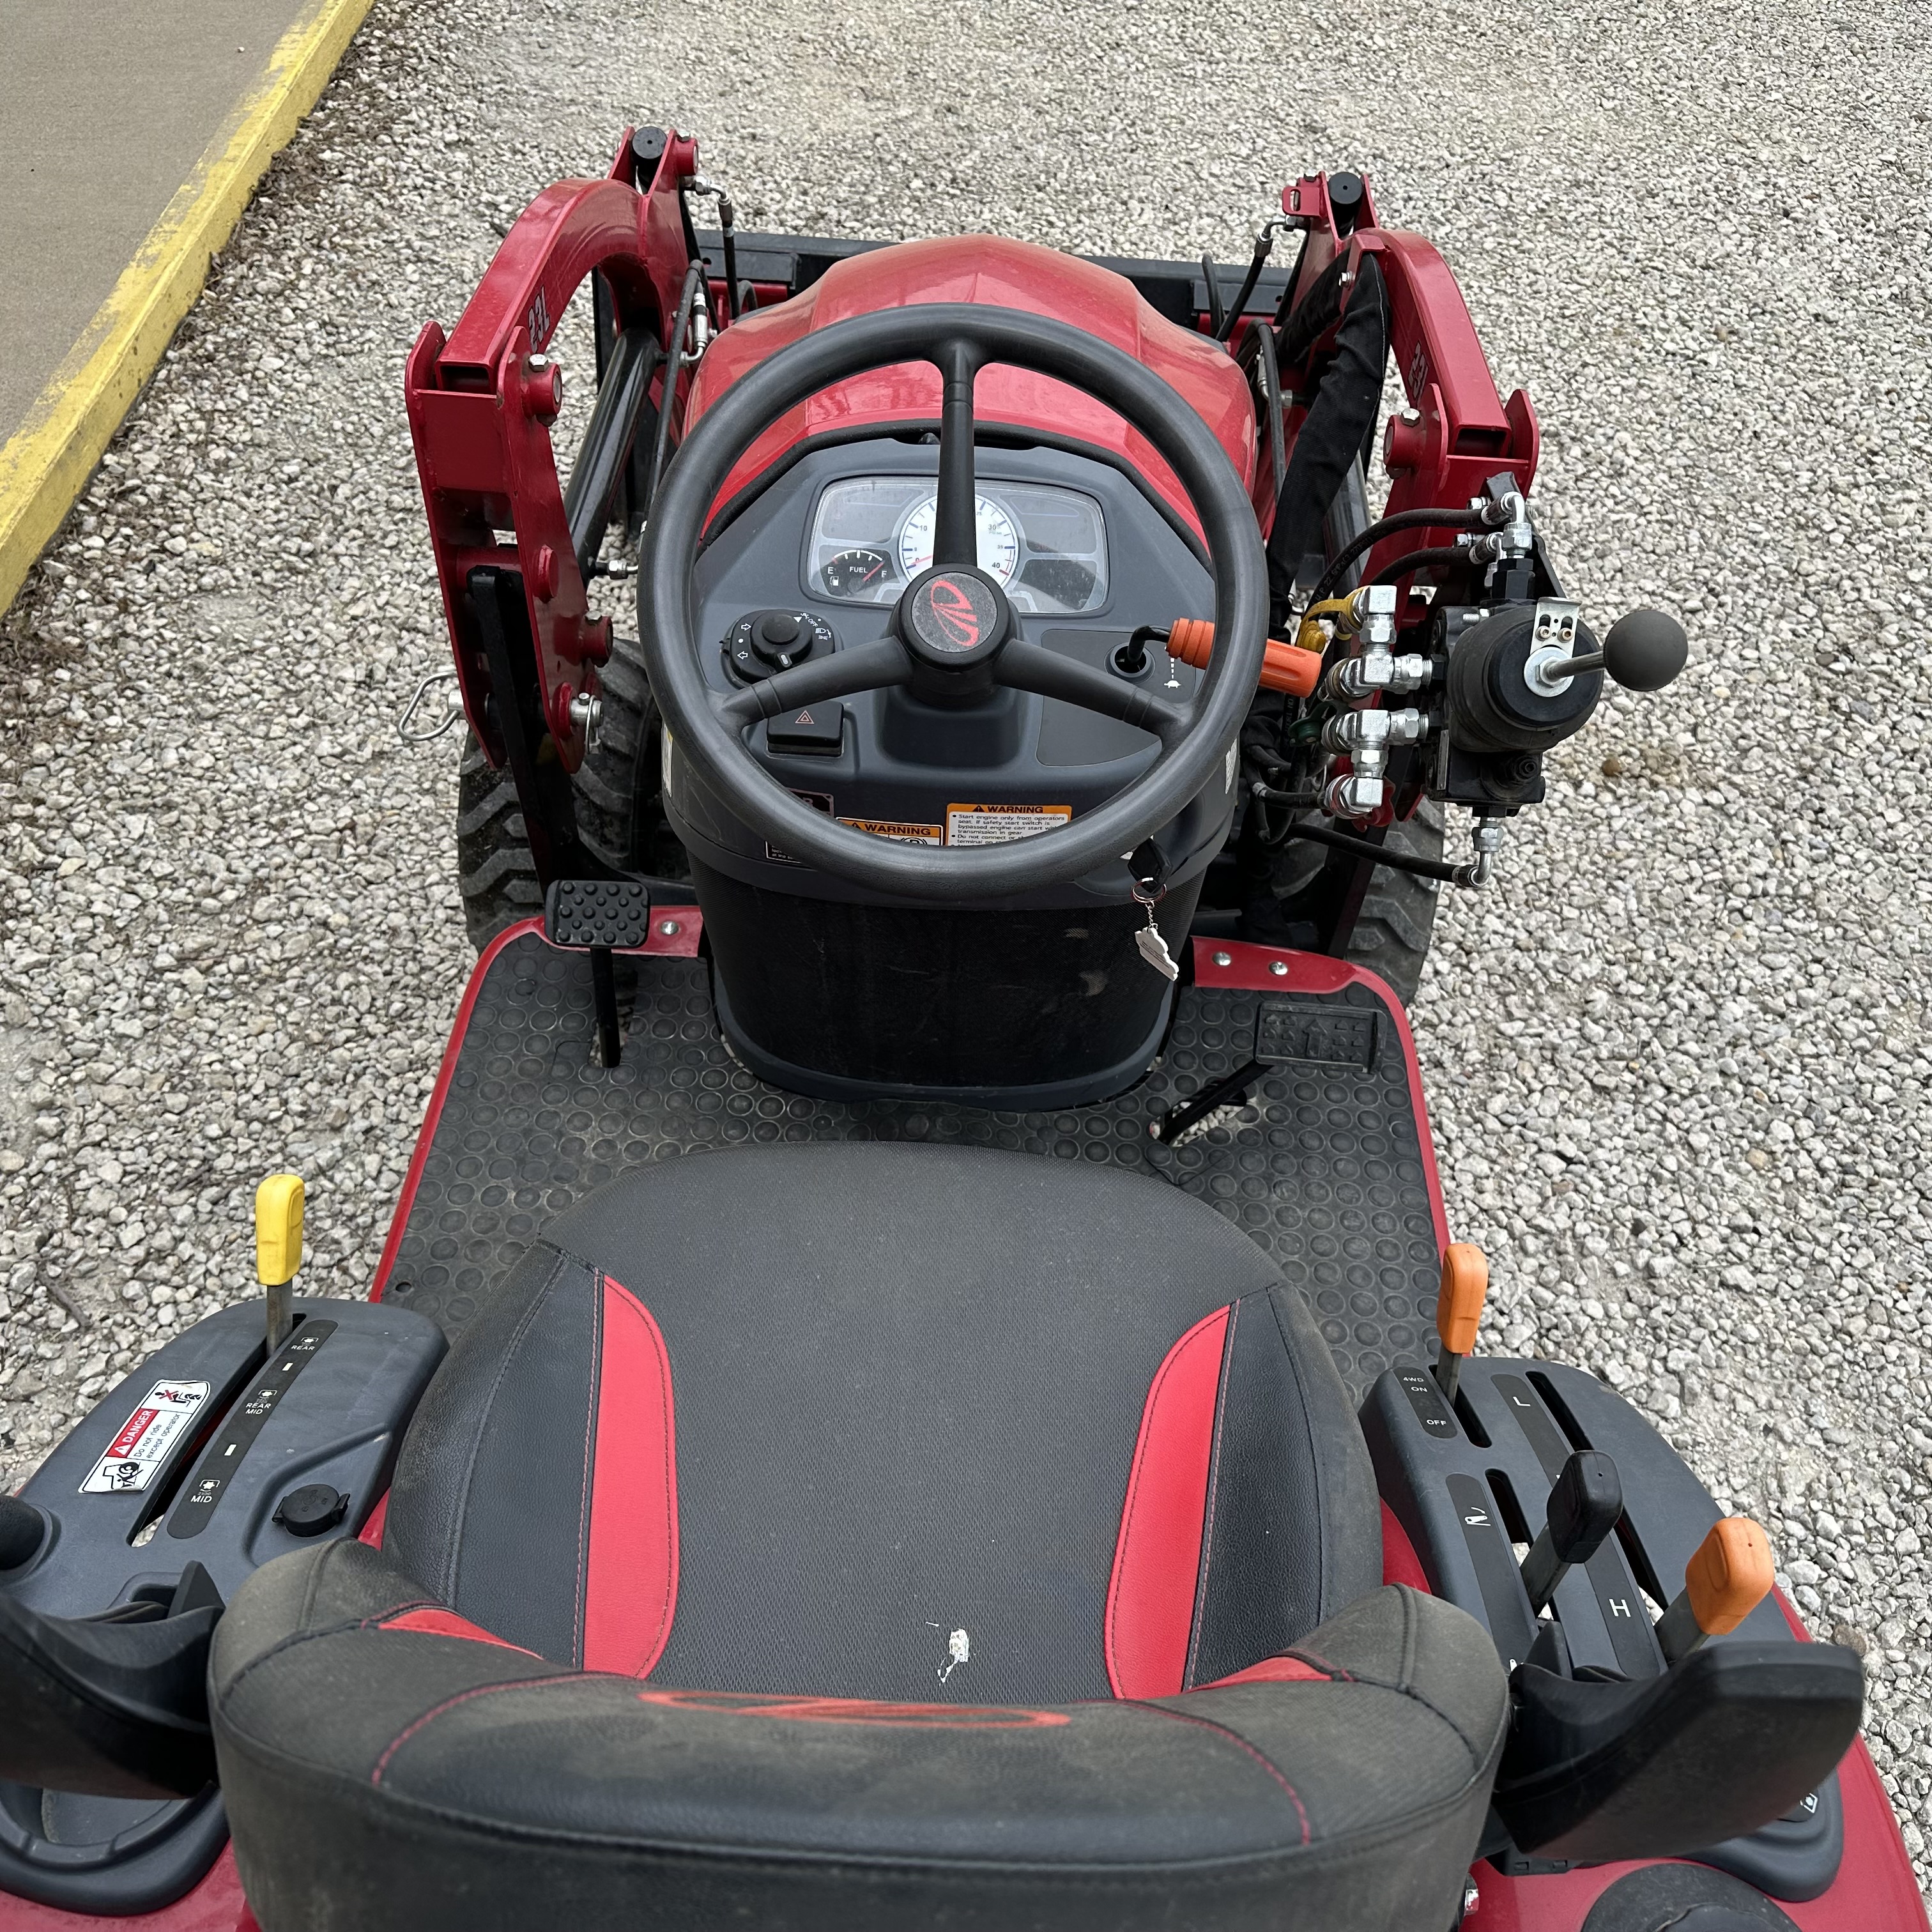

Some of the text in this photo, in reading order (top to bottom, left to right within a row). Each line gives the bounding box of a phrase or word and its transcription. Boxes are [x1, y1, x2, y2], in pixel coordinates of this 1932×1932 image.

[808, 618, 818, 627] OFF
[864, 824, 931, 836] WARNING
[1513, 1396, 1531, 1407] L
[122, 1410, 154, 1443] DANGER
[146, 1414, 181, 1458] except operator
[134, 1424, 162, 1457] Do not ride
[1609, 1598, 1631, 1618] H
